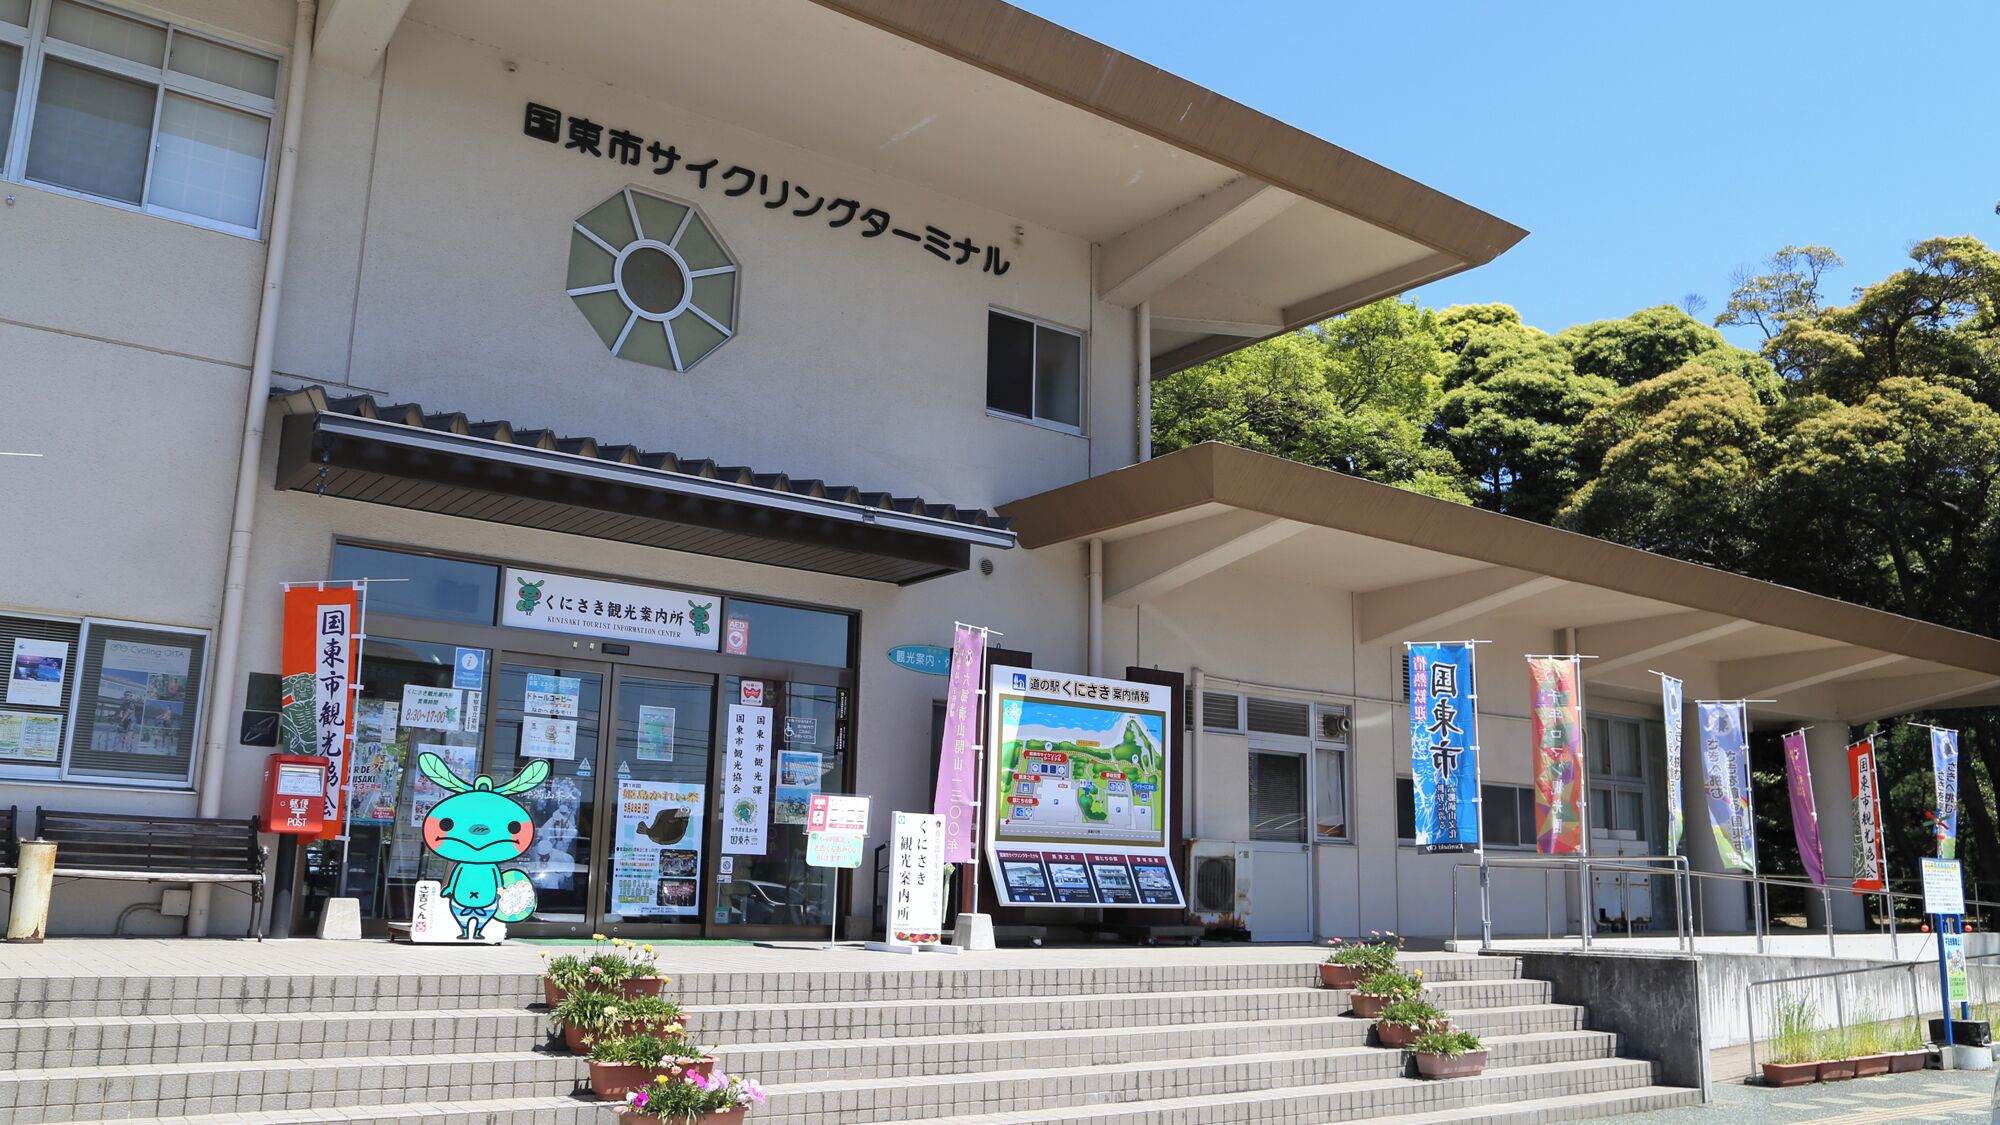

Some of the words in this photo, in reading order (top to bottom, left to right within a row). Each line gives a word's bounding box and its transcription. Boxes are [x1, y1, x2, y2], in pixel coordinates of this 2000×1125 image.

[524, 102, 1010, 277] 国東市サイクリングターミナル
[546, 595, 684, 626] くにさき観光案内所
[547, 616, 580, 626] KUNISAKI
[583, 620, 611, 630] TOURIST
[613, 624, 656, 635] INFORMATION
[658, 629, 681, 638] CENTER
[407, 688, 454, 699] くにさき観光案内所
[527, 691, 573, 703] ドトールコーヒー
[732, 713, 745, 795] 国東市観光協会
[752, 715, 766, 795] 国東市観光課
[289, 798, 309, 810] 郵便
[1859, 757, 1877, 880] 国東市観光協会
[287, 818, 307, 827] POST
[916, 820, 928, 885] くにさき
[897, 836, 913, 921] 観光案内所
[417, 885, 430, 920] さ吉くん
